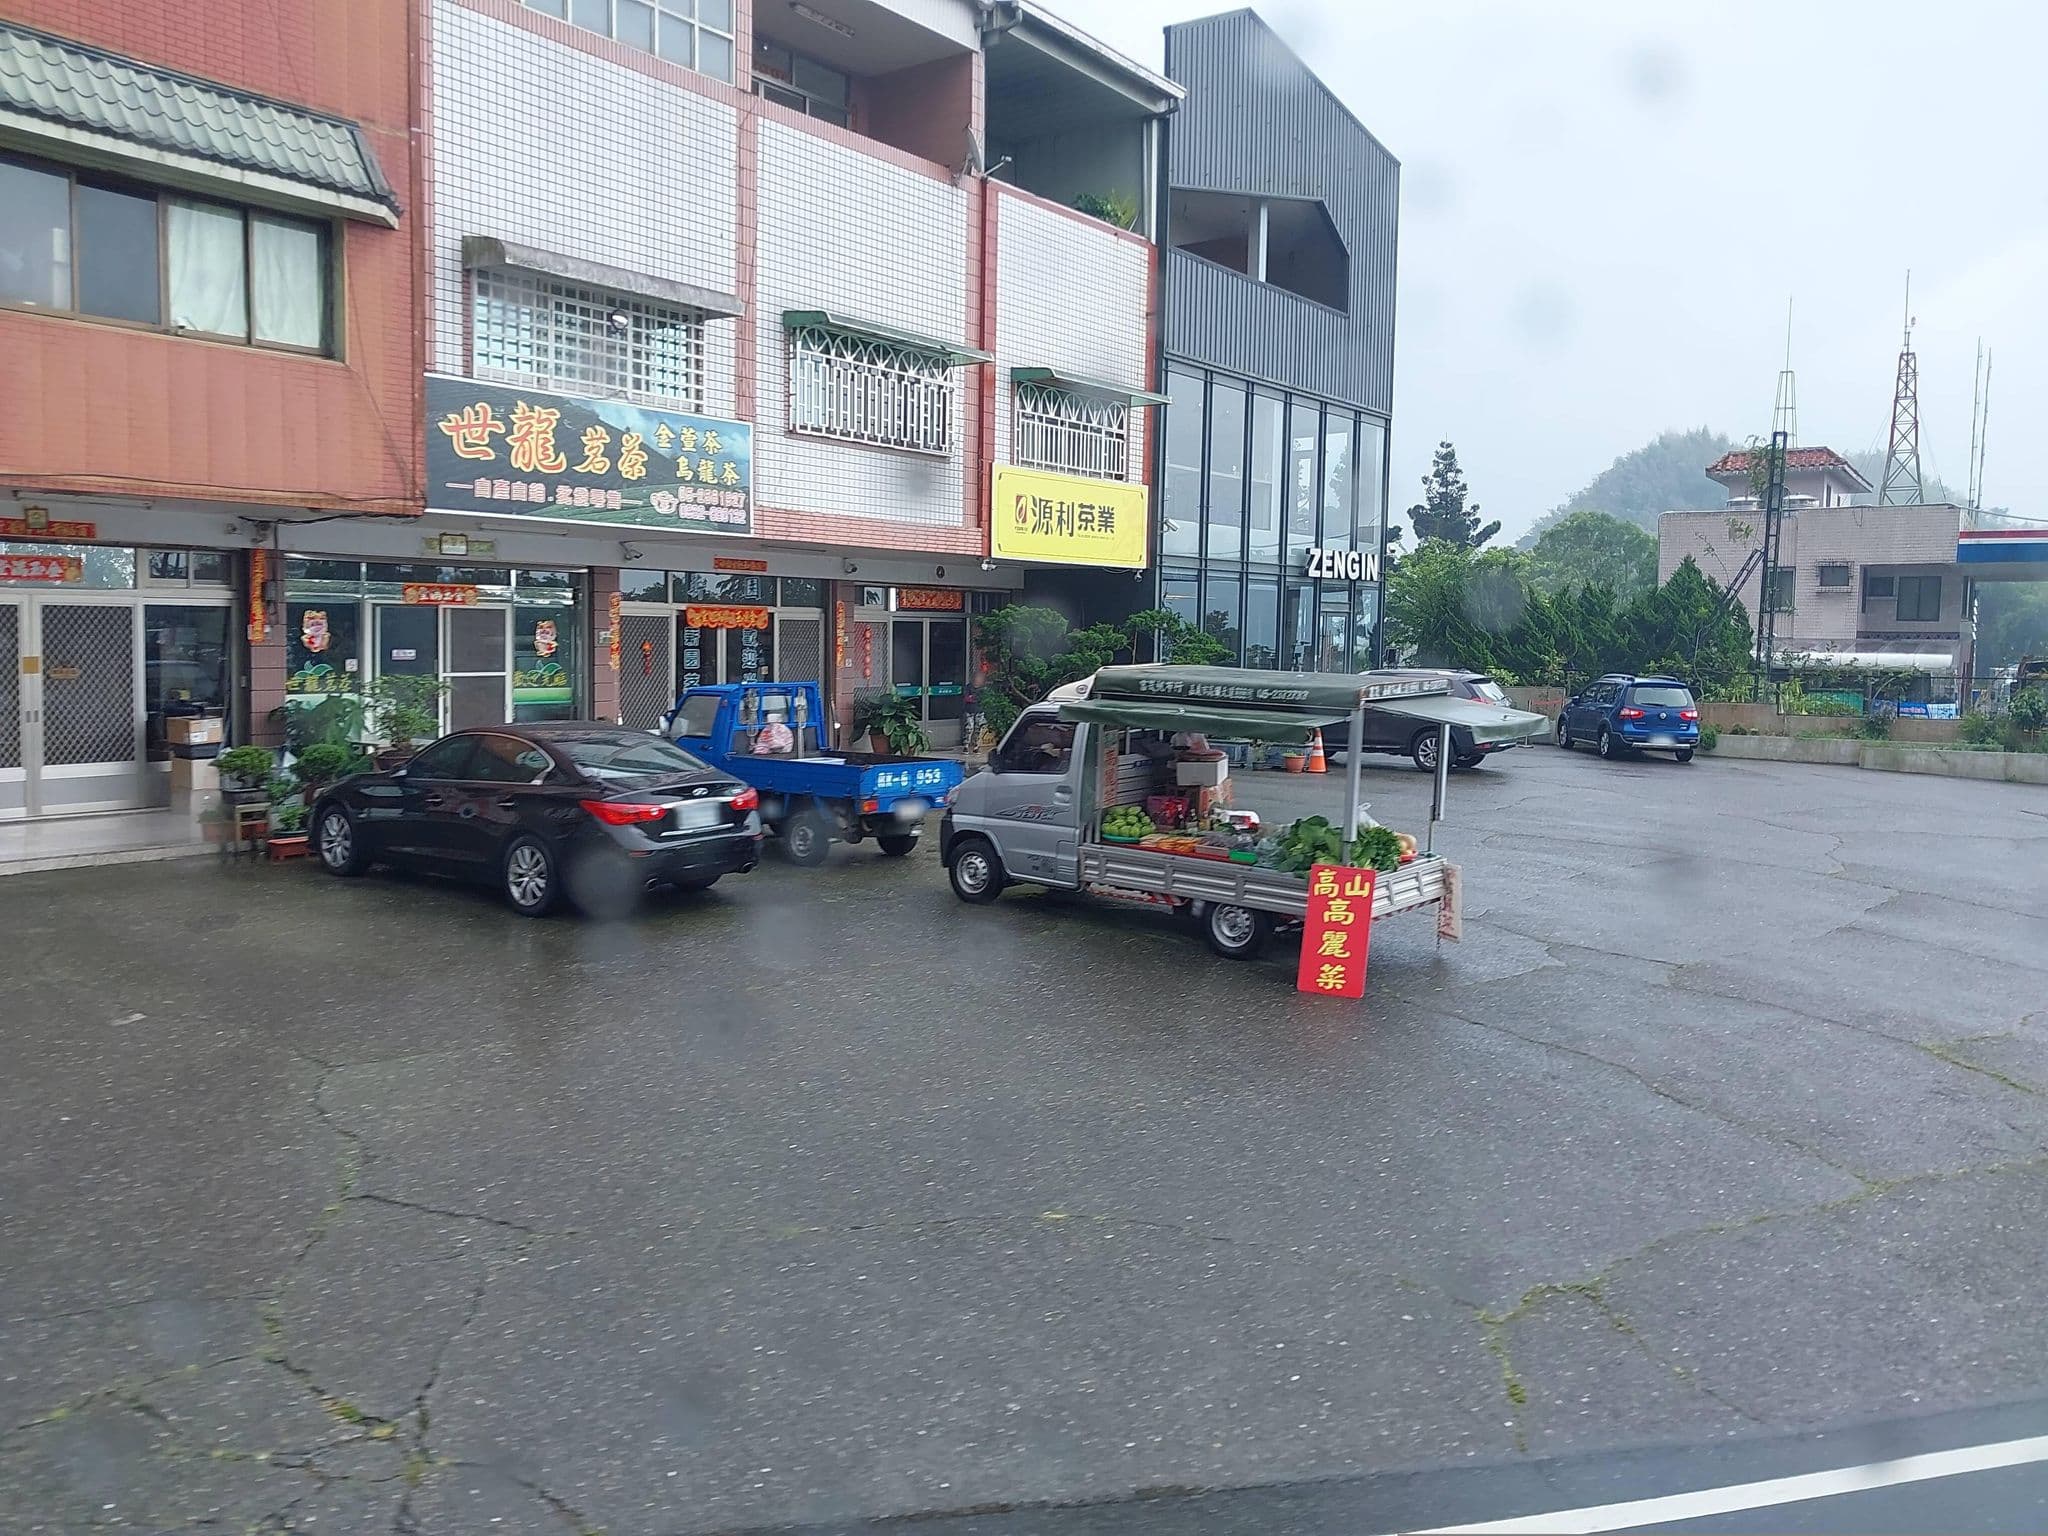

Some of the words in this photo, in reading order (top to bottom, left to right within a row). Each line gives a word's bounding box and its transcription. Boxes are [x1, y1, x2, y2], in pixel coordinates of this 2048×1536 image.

[438, 400, 649, 481] 世龍茗茶
[654, 422, 723, 455] 金萱茶
[675, 455, 741, 486] 烏龍茶
[1030, 494, 1115, 538] 源利茶業
[1307, 547, 1379, 582] ZENGIN
[1314, 898, 1355, 991] 高麗菜
